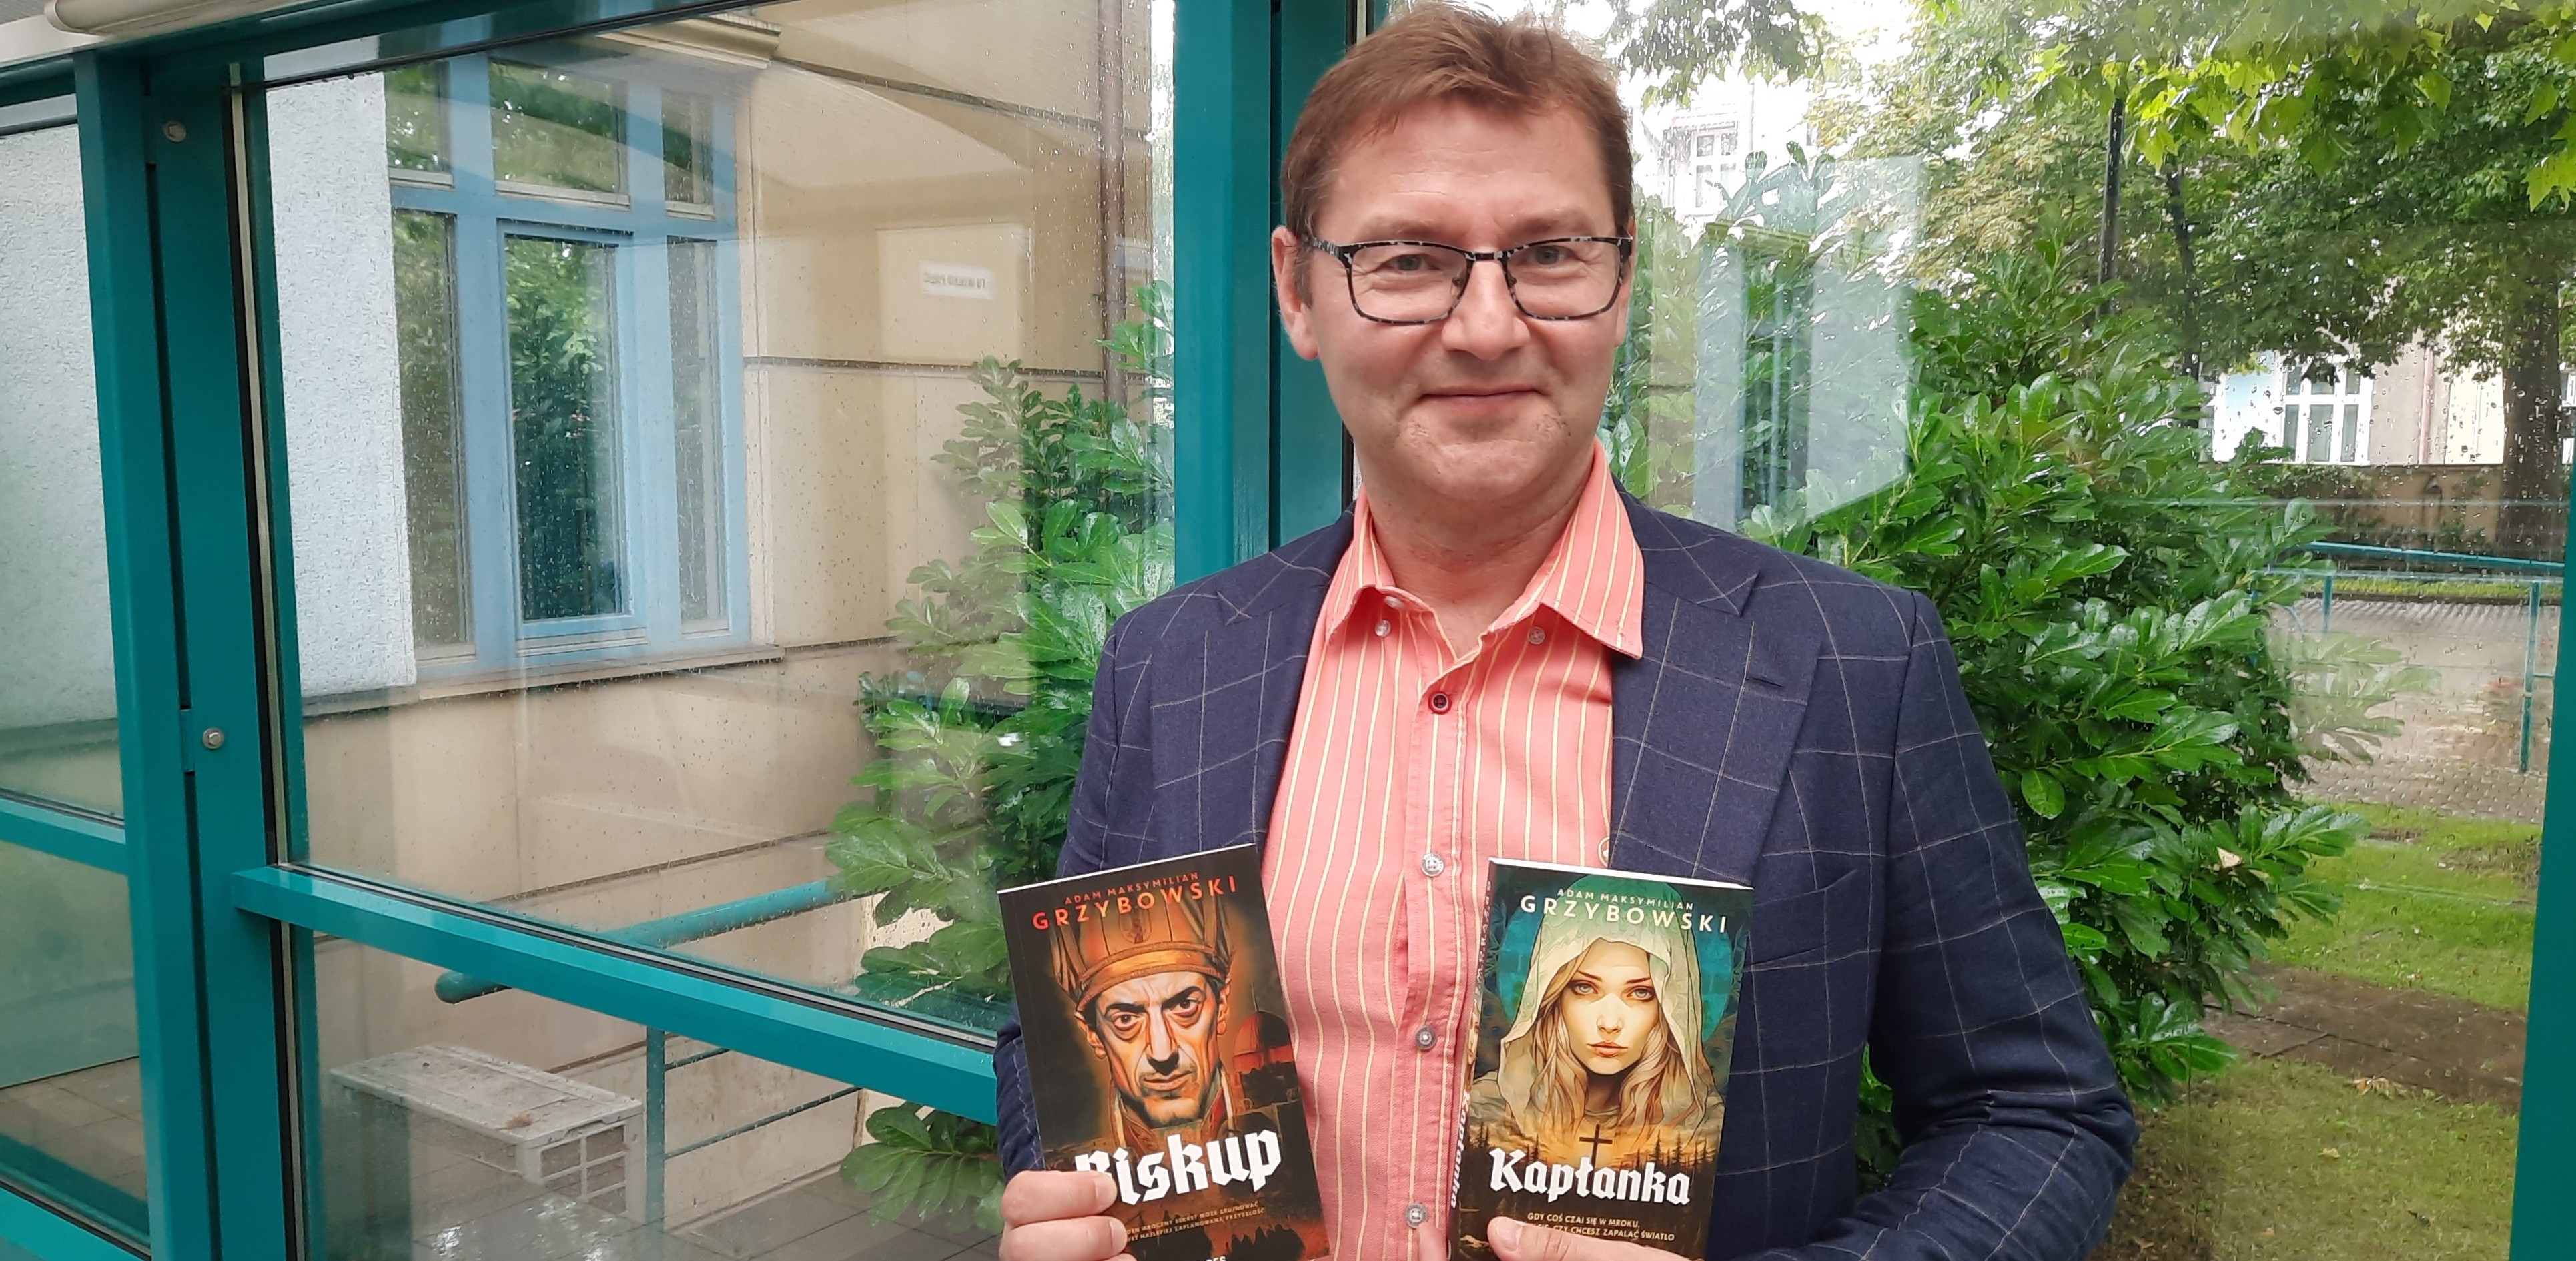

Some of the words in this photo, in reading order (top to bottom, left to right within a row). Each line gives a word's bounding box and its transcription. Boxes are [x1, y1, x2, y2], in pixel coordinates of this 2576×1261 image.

[1032, 875, 1236, 930] GRZYBOWSKI
[1065, 891, 1101, 905] ADAM
[1108, 872, 1198, 896] MAKSYMILIAN
[1557, 889, 1594, 900] ADAM
[1601, 893, 1693, 911] MAKSYMILIAN
[1521, 895, 1727, 933] GRZYBOWSKI
[1489, 1148, 1691, 1205] Kapłanka
[1527, 1212, 1545, 1220] GDY
[1547, 1213, 1563, 1222] COŚ
[1565, 1215, 1584, 1224] CZAI
[1585, 1216, 1597, 1226] SIĘ
[1571, 1226, 1600, 1236] CHCESZ
[1603, 1228, 1639, 1239] ZAPALAĆ
[1641, 1230, 1675, 1241] ŚWIATŁO
